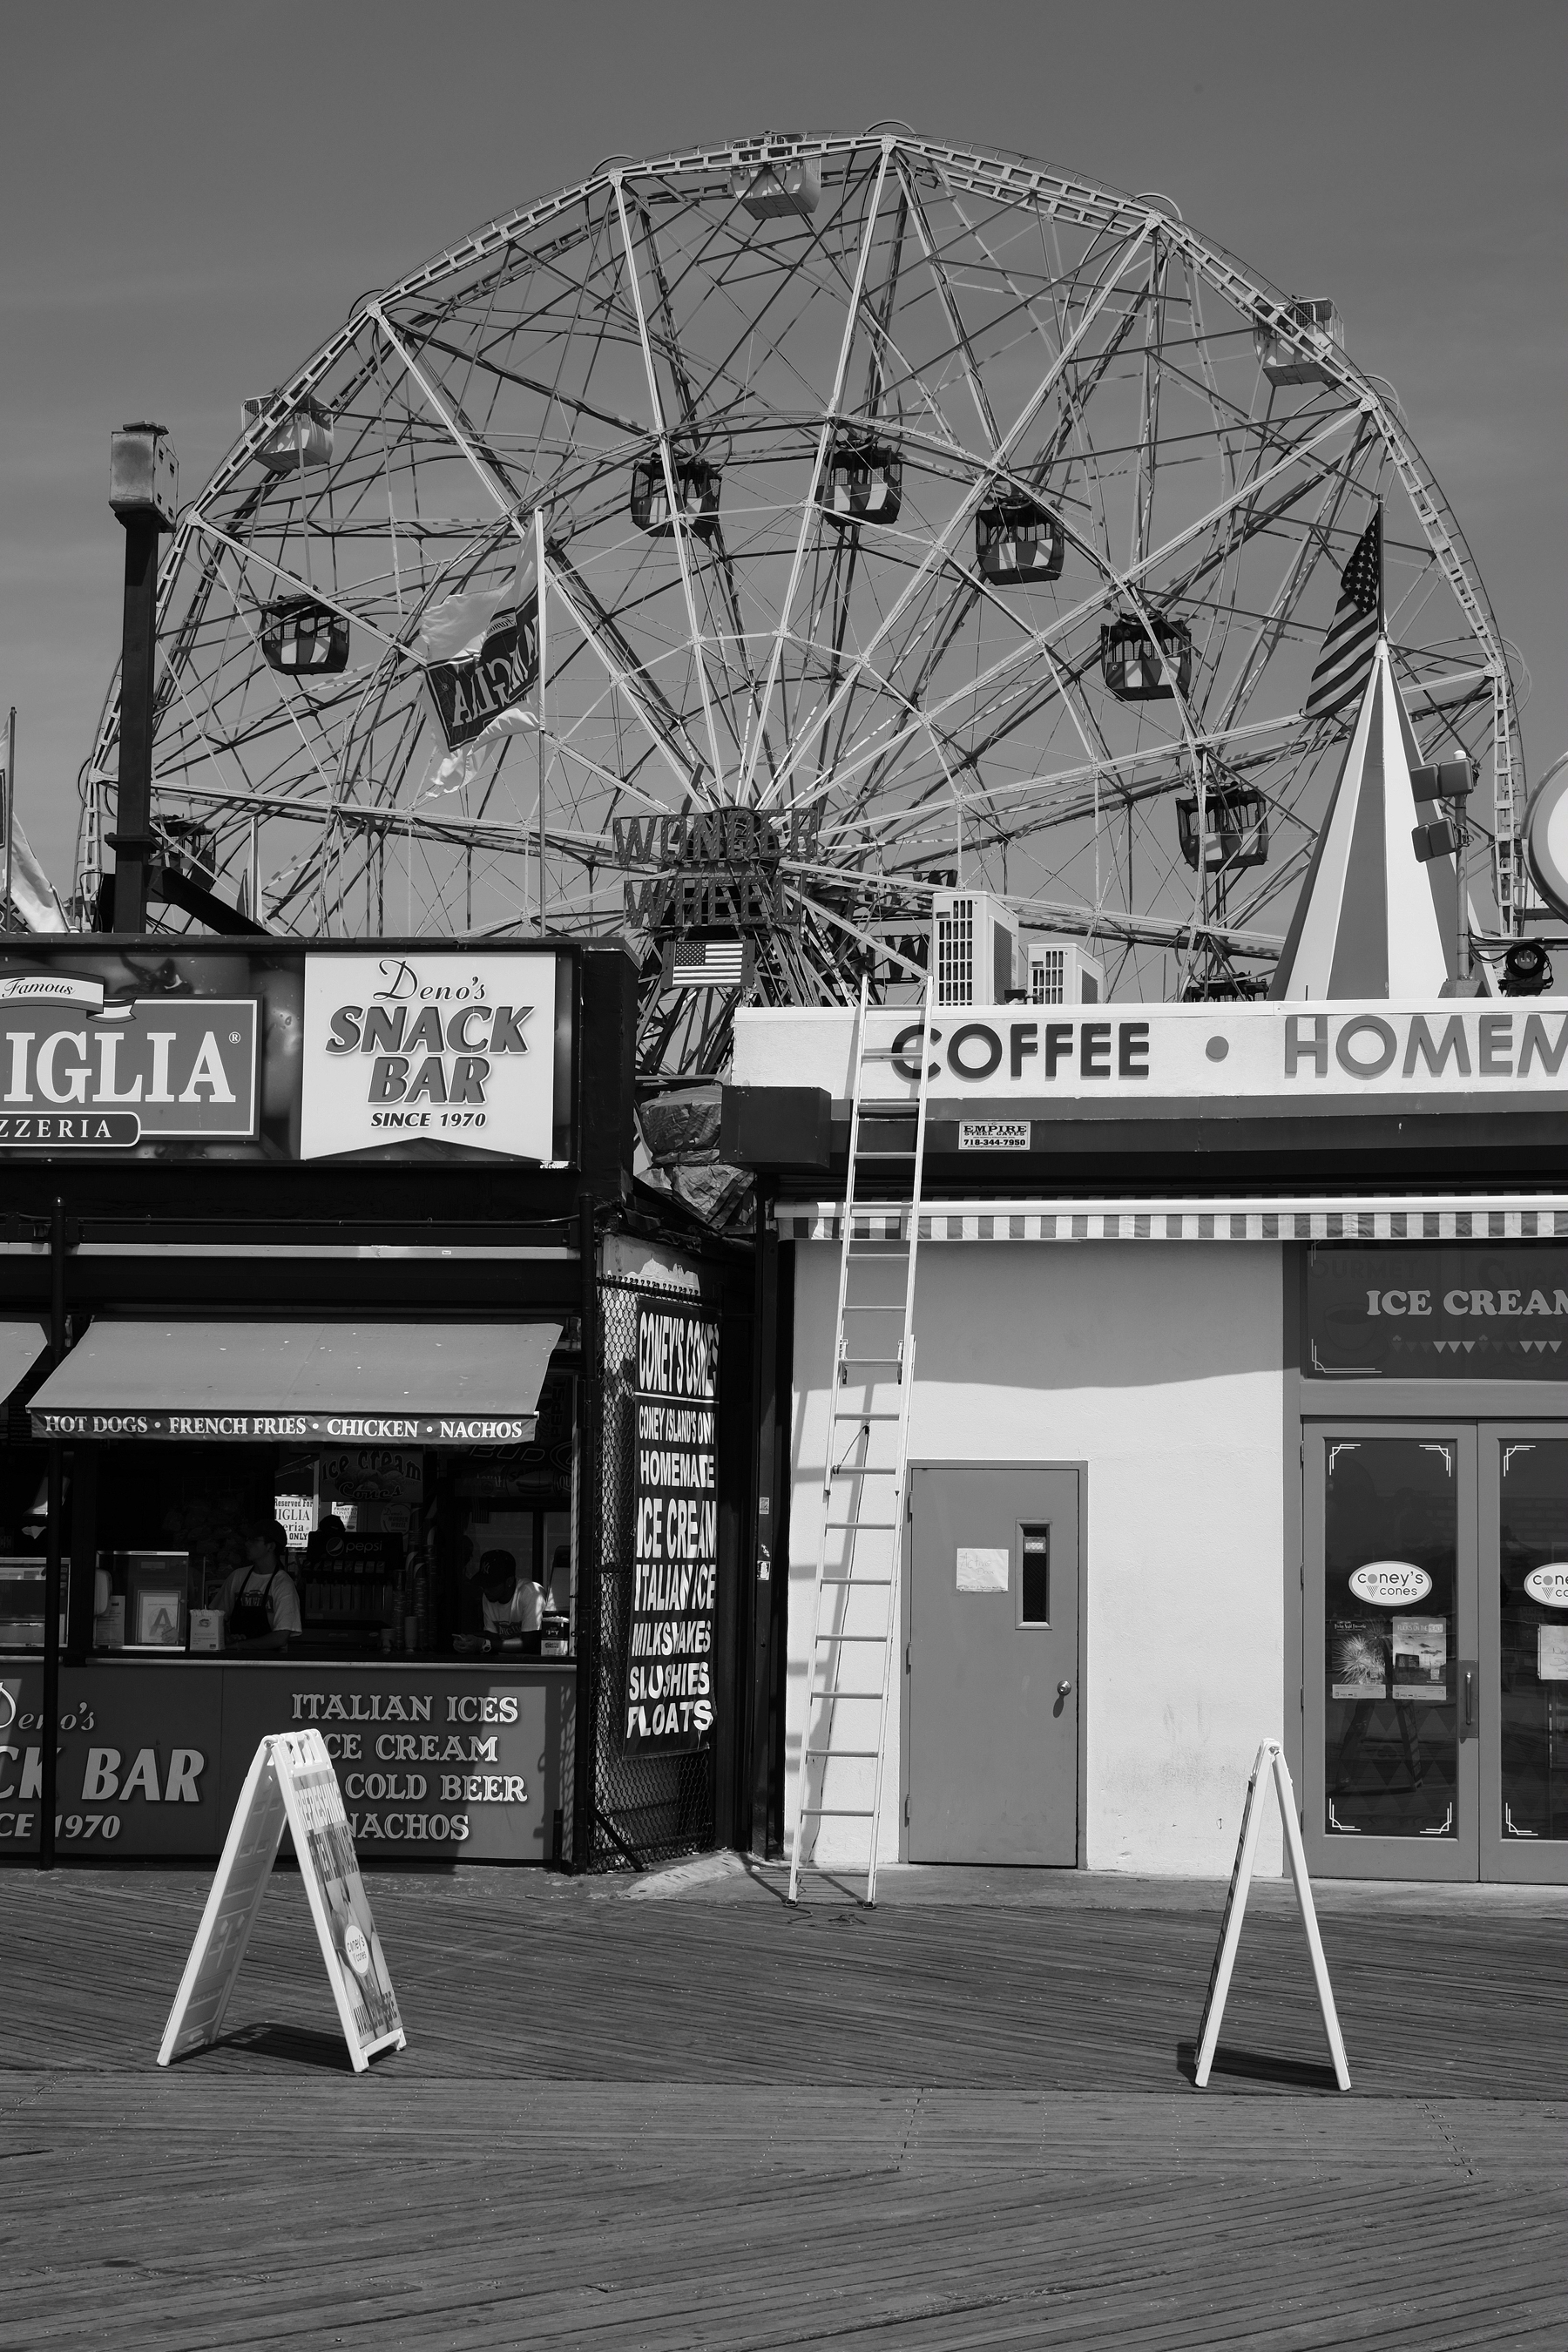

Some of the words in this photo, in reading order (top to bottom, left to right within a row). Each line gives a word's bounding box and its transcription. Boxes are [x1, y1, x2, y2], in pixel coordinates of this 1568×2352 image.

[613, 808, 818, 864] WONDER
[624, 874, 802, 928] WHEEL
[2, 977, 75, 998] Famous
[373, 959, 486, 1001] Deno's
[325, 1005, 535, 1053] SNACK
[891, 1023, 1150, 1079] COFFEE
[368, 1057, 490, 1104] BAR
[371, 1112, 431, 1127] SINCE
[440, 1112, 486, 1127] 1970
[1367, 1289, 1432, 1315] ICE
[639, 1311, 685, 1395] CONEY'S
[44, 1416, 87, 1432] HOT
[92, 1416, 148, 1433] DOGS
[169, 1417, 247, 1435] FRENCH
[253, 1417, 307, 1435] FRIES
[327, 1419, 420, 1437] CHICKEN
[440, 1421, 522, 1439] NACHOS
[639, 1405, 665, 1441] CONEY
[666, 1408, 697, 1444] ISLAND'S
[470, 1445, 545, 1462] BUD
[302, 1498, 313, 1507] For
[340, 1481, 403, 1500] Cones
[289, 1532, 308, 1541] ONLY
[636, 1497, 663, 1559] ICE
[346, 1540, 382, 1554] pepsi
[959, 1552, 992, 1569] Active
[635, 1565, 693, 1612] ITALIAN
[1357, 1571, 1423, 1587] coney's
[1533, 1574, 1568, 1585] con
[1380, 1587, 1418, 1596] cones
[149, 1608, 172, 1636] A
[629, 1662, 710, 1700] SLUSHIES
[292, 1693, 433, 1721] ITALIAN
[447, 1696, 518, 1723] ICES
[626, 1700, 713, 1739] FLOATS
[323, 1733, 362, 1759] CE
[375, 1734, 498, 1762] CREAM
[81, 1747, 205, 1802] BAR
[345, 1773, 427, 1800] COLD
[440, 1774, 528, 1802] BEER
[294, 1781, 346, 1833] REFRESHING
[55, 1814, 121, 1839] 1970
